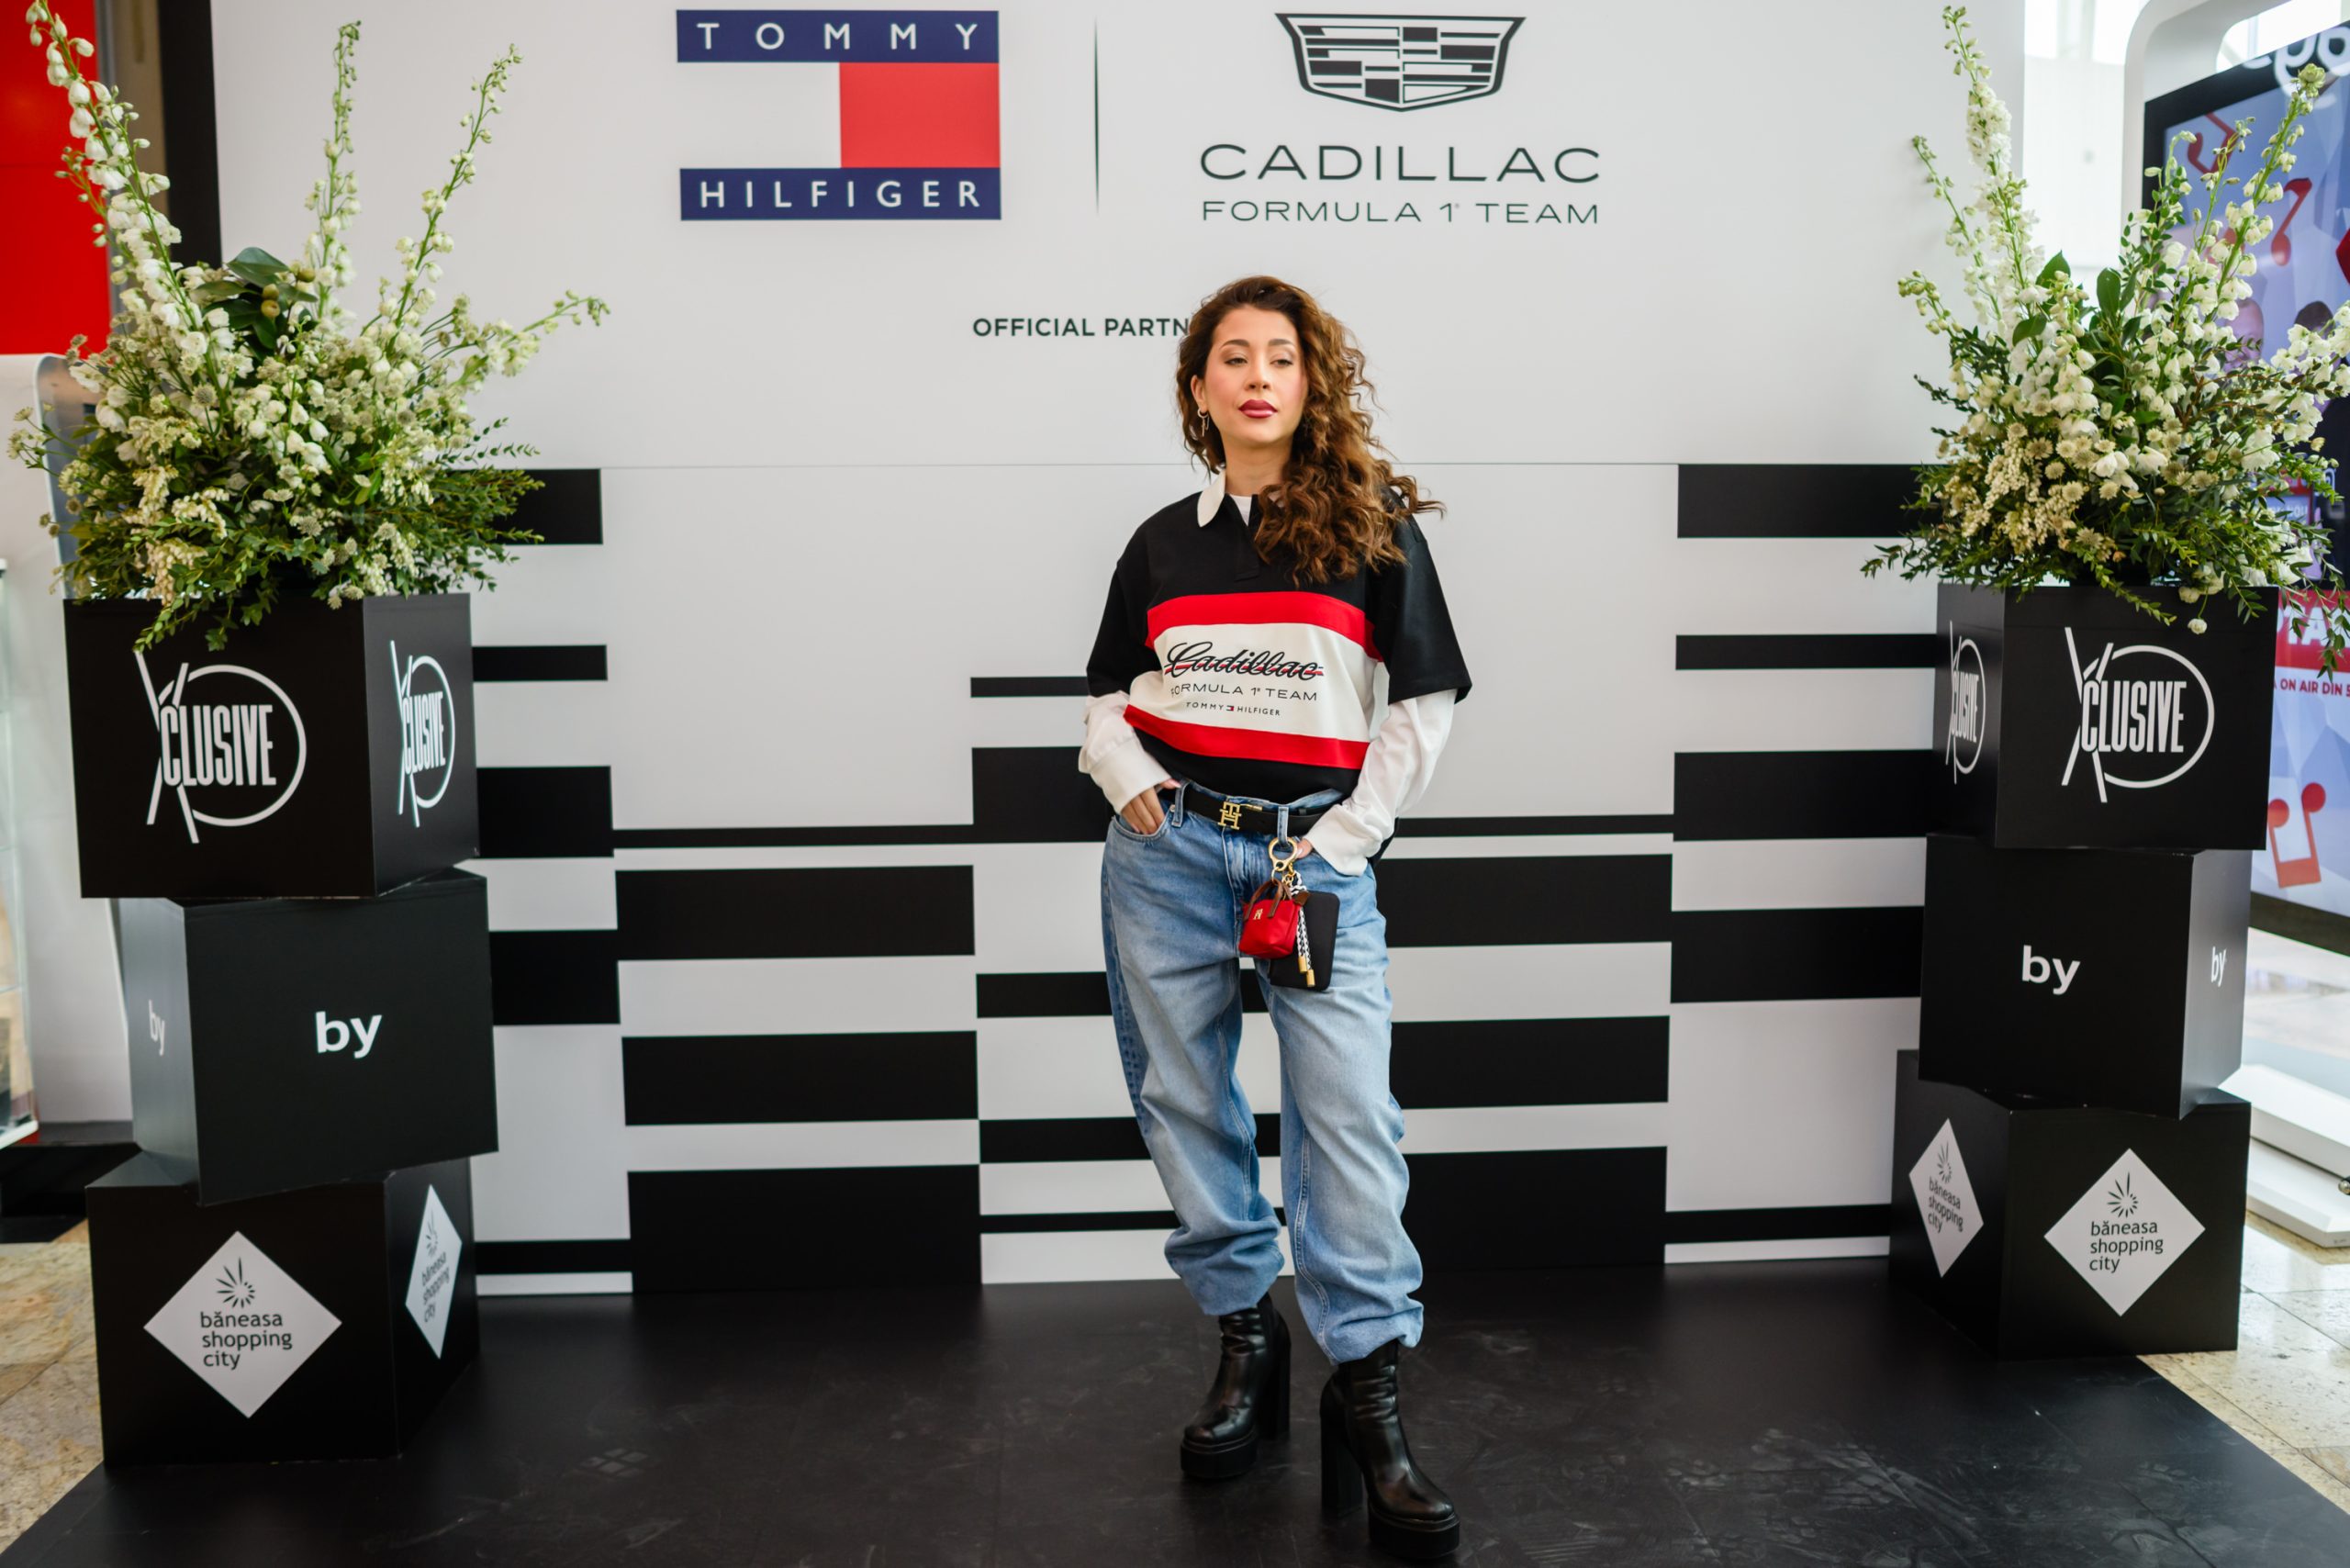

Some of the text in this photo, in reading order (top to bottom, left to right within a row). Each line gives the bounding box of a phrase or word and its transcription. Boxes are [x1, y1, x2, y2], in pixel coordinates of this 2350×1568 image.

[696, 22, 979, 50] TOMMY
[1200, 142, 1600, 184] CADILLAC
[699, 180, 980, 208] HILFIGER
[1203, 200, 1422, 222] FORMULA
[1475, 203, 1598, 224] TEAM
[972, 318, 1191, 337] OFFICIAL PARTN
[1164, 641, 1320, 681] Cadillac
[1265, 688, 1317, 701] TEAM
[2280, 678, 2297, 691] ON
[2300, 679, 2319, 694] AIR
[2322, 681, 2343, 697] DIN
[1186, 701, 1281, 716] TOMMY HILFIGER
[2021, 945, 2081, 996] by
[2210, 946, 2227, 988] by
[149, 999, 166, 1056] by
[315, 1011, 383, 1058] by
[2090, 1221, 2158, 1237] băneasa
[2089, 1237, 2165, 1257] shopping
[2088, 1256, 2121, 1274] city
[199, 1311, 284, 1328] băneasa
[202, 1330, 293, 1350] shopping
[203, 1350, 241, 1371] city
